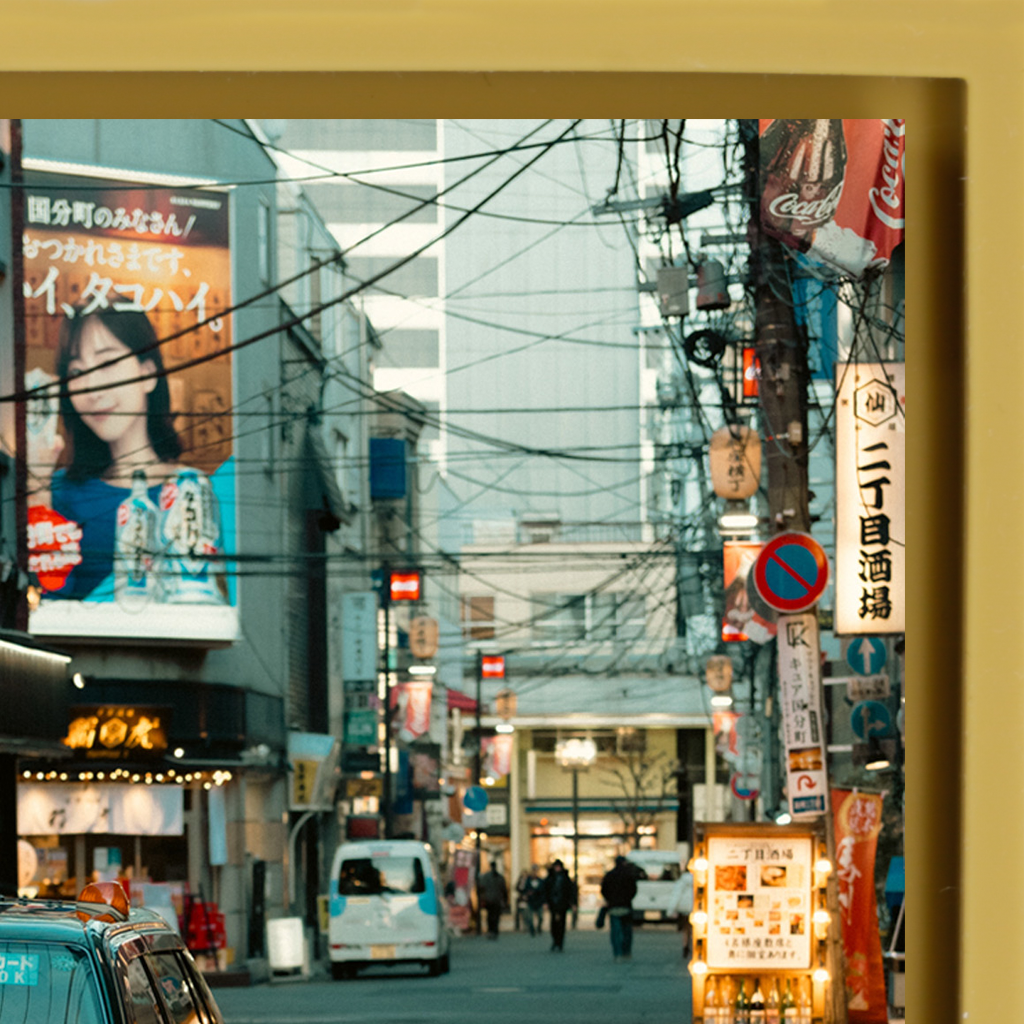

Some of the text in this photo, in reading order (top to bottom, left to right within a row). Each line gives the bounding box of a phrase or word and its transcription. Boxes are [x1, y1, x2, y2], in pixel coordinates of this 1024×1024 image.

[857, 441, 893, 621] 二丁目酒場
